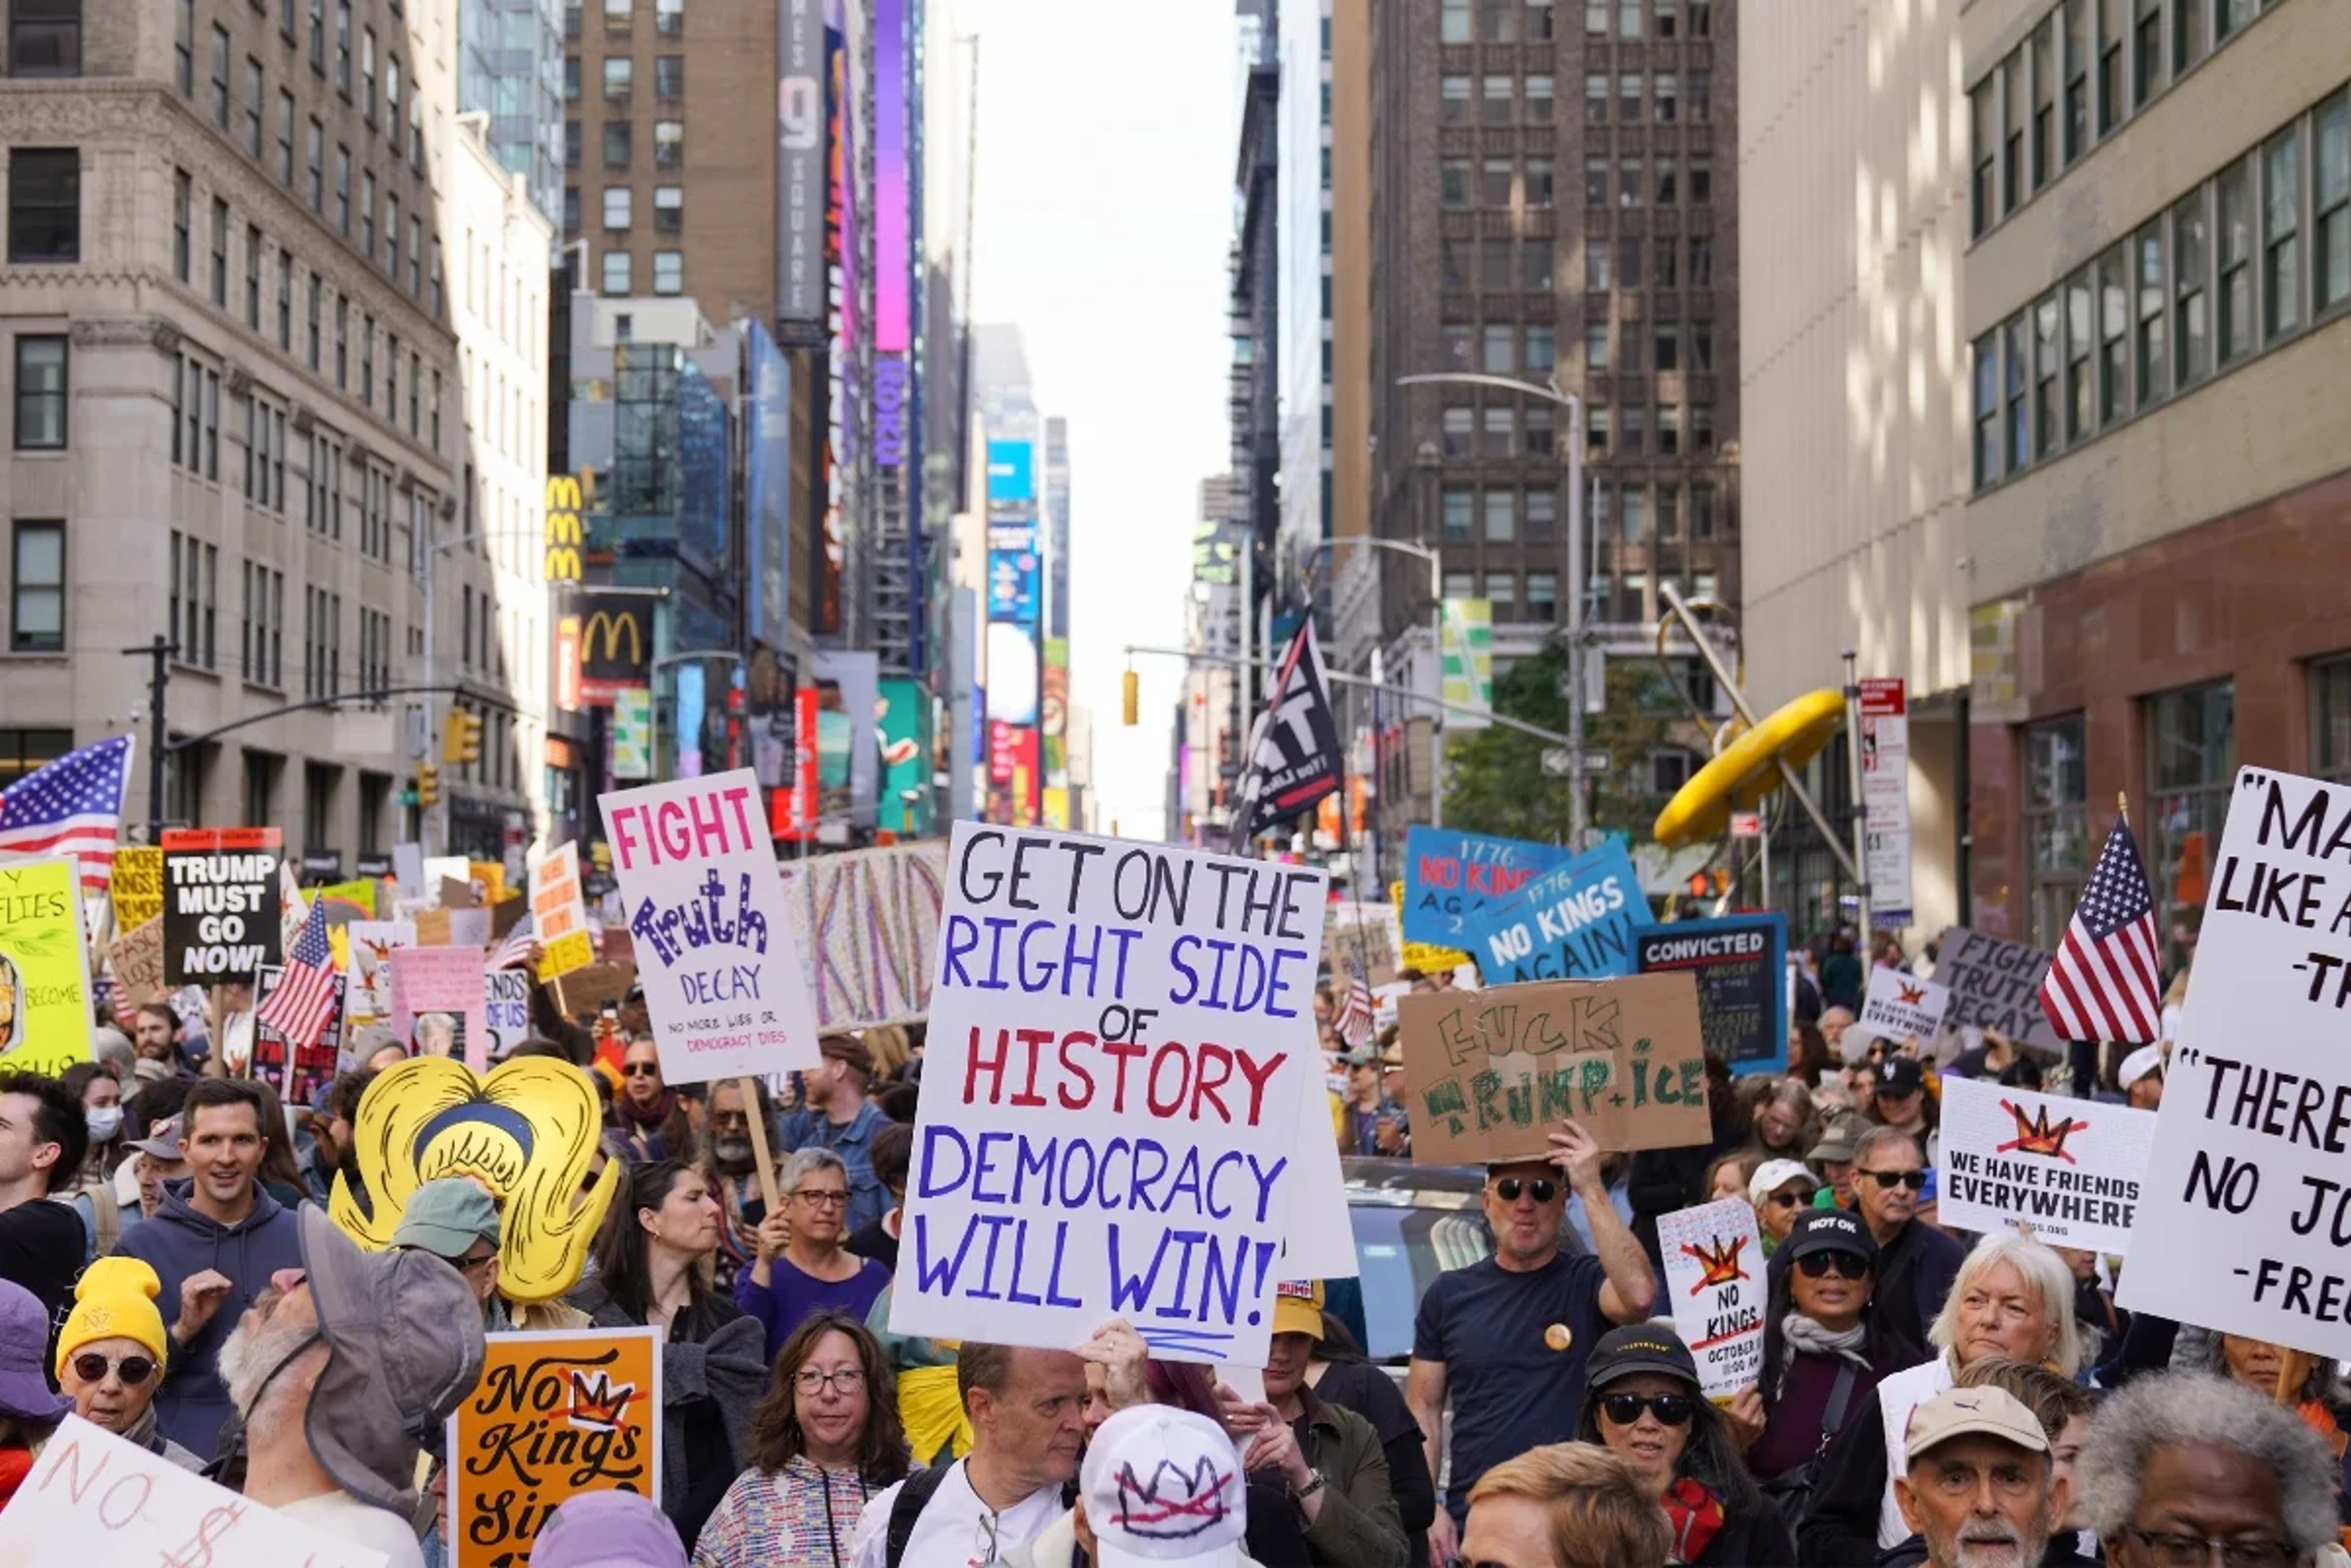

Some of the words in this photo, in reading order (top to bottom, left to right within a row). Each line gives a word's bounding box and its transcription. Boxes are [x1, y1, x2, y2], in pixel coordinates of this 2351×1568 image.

[779, 76, 817, 149] 9
[611, 787, 753, 869] FIGHT
[168, 855, 276, 885] TRUMP
[1418, 854, 1460, 888] NO
[1460, 839, 1514, 866] 1776
[178, 885, 265, 914] MUST
[959, 831, 1104, 914] GET
[1114, 848, 1194, 926] ON
[1207, 862, 1321, 940] THE
[1528, 869, 1572, 904] 1776
[2216, 857, 2327, 928] LIKE
[0, 891, 66, 925] LIES
[631, 868, 767, 969] Truth
[1488, 922, 1532, 967] NO
[1535, 875, 1624, 944] KINGS
[198, 915, 245, 943] GO
[1645, 932, 1764, 963] CONVICTED
[183, 945, 265, 973] NOW!
[942, 915, 1142, 999] RIGHT
[1169, 934, 1308, 1018] SIDE
[1958, 933, 2052, 978] FIGH
[23, 983, 81, 1010] BECOME
[680, 964, 761, 1005] DECAY
[505, 1003, 527, 1027] US
[668, 1022, 684, 1033] NO
[687, 1018, 720, 1032] MORE
[761, 1010, 777, 1024] OR
[1099, 1004, 1159, 1045] OF
[1438, 996, 1622, 1067] FUCK
[686, 1033, 752, 1053] DEMOCRACY
[757, 1030, 787, 1046] DIES
[962, 1026, 1288, 1127] HISTORY
[918, 1125, 1288, 1223] DEMOCRACY
[1949, 1150, 1981, 1174] WE
[1985, 1157, 2039, 1185] HAVE
[2045, 1168, 2140, 1201] FRIENDS
[2183, 1150, 2259, 1215] NO
[1949, 1173, 2137, 1229] EVERYWHERE
[1808, 1216, 1837, 1232] NOT
[1837, 1218, 1857, 1234] OK
[915, 1214, 1082, 1308] WILL
[1108, 1224, 1277, 1326] WIN!
[1277, 1283, 1310, 1296] RUMP
[1717, 1283, 1739, 1311] NO
[1706, 1305, 1758, 1341] KINGS
[1708, 1339, 1755, 1364] OCTOBER
[476, 1348, 619, 1415] No
[465, 1419, 643, 1487] Kings
[38, 1440, 154, 1530] NO
